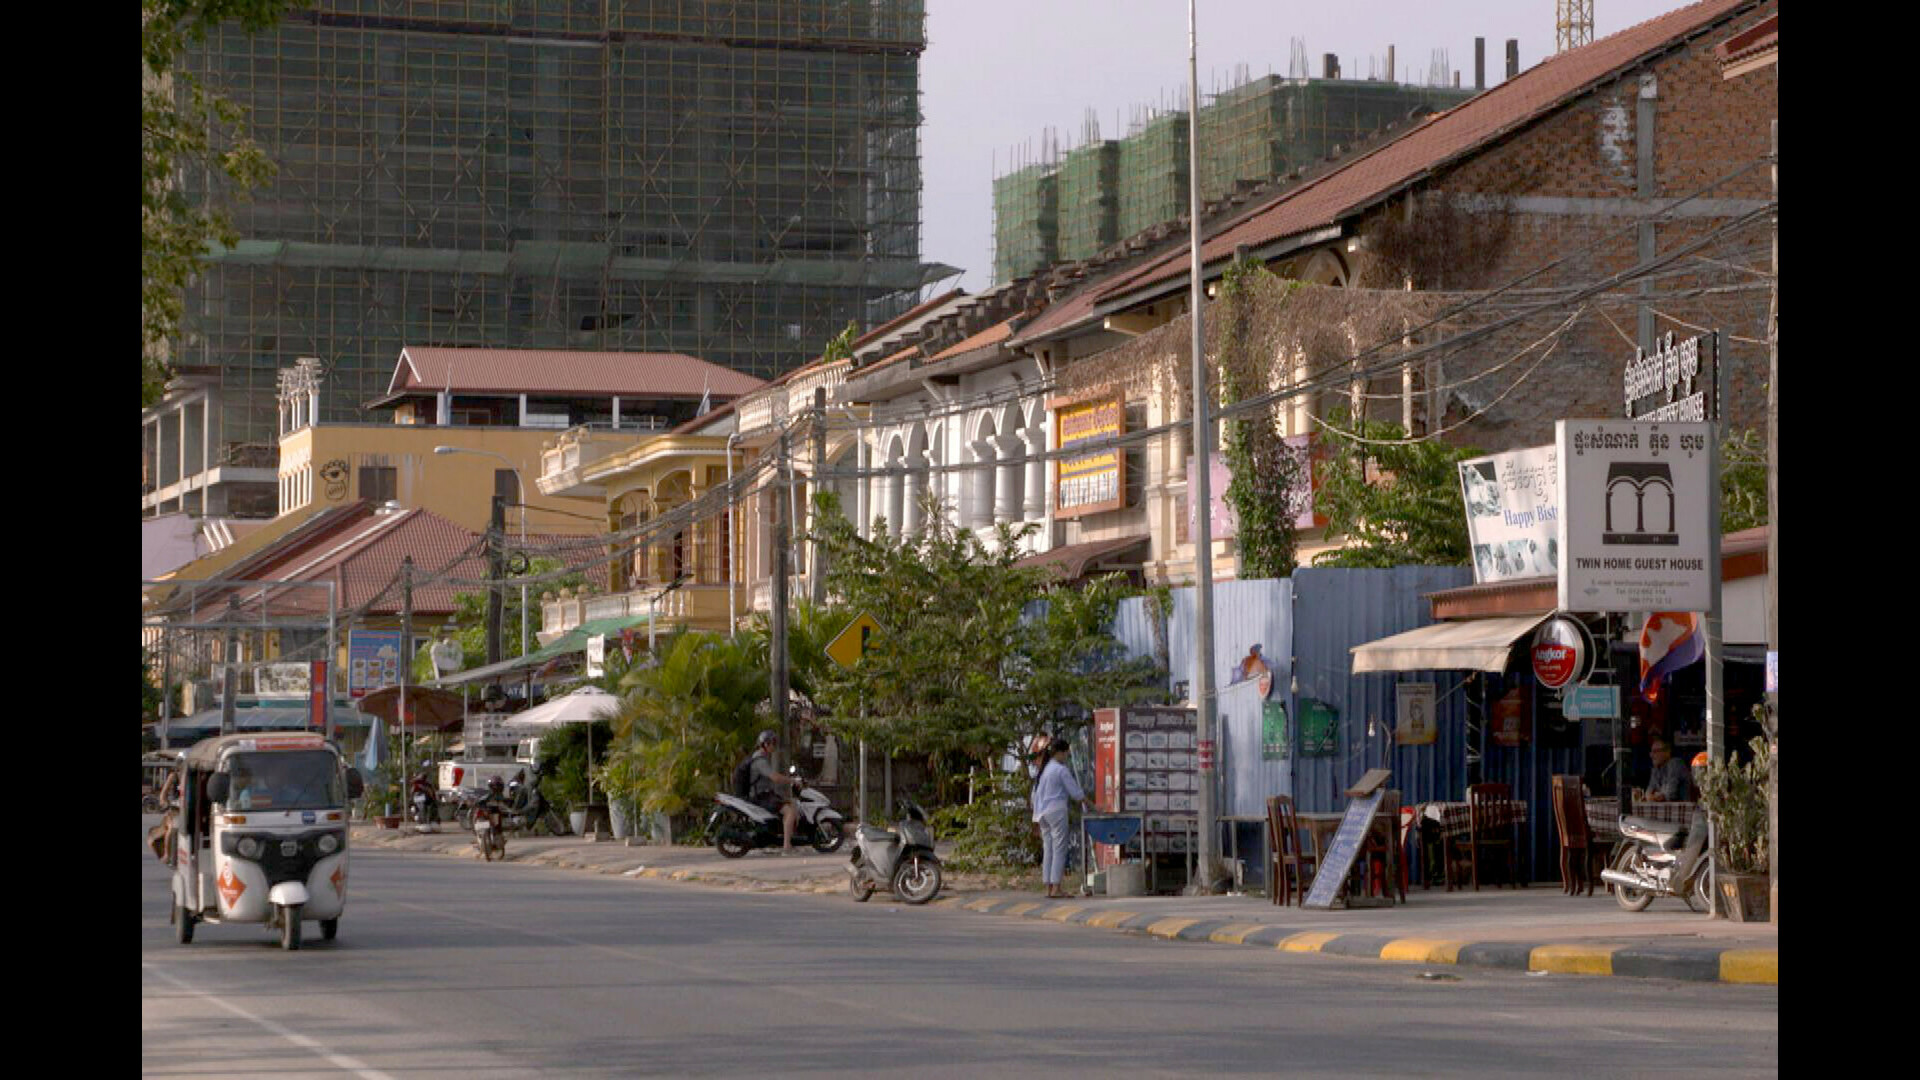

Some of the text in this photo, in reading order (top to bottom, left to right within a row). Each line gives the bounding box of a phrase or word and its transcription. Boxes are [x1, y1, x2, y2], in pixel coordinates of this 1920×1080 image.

[1503, 509, 1535, 528] Happy
[1576, 558, 1704, 570] TWIN HOME GUEST HOUSE
[1535, 647, 1568, 664] Angkor
